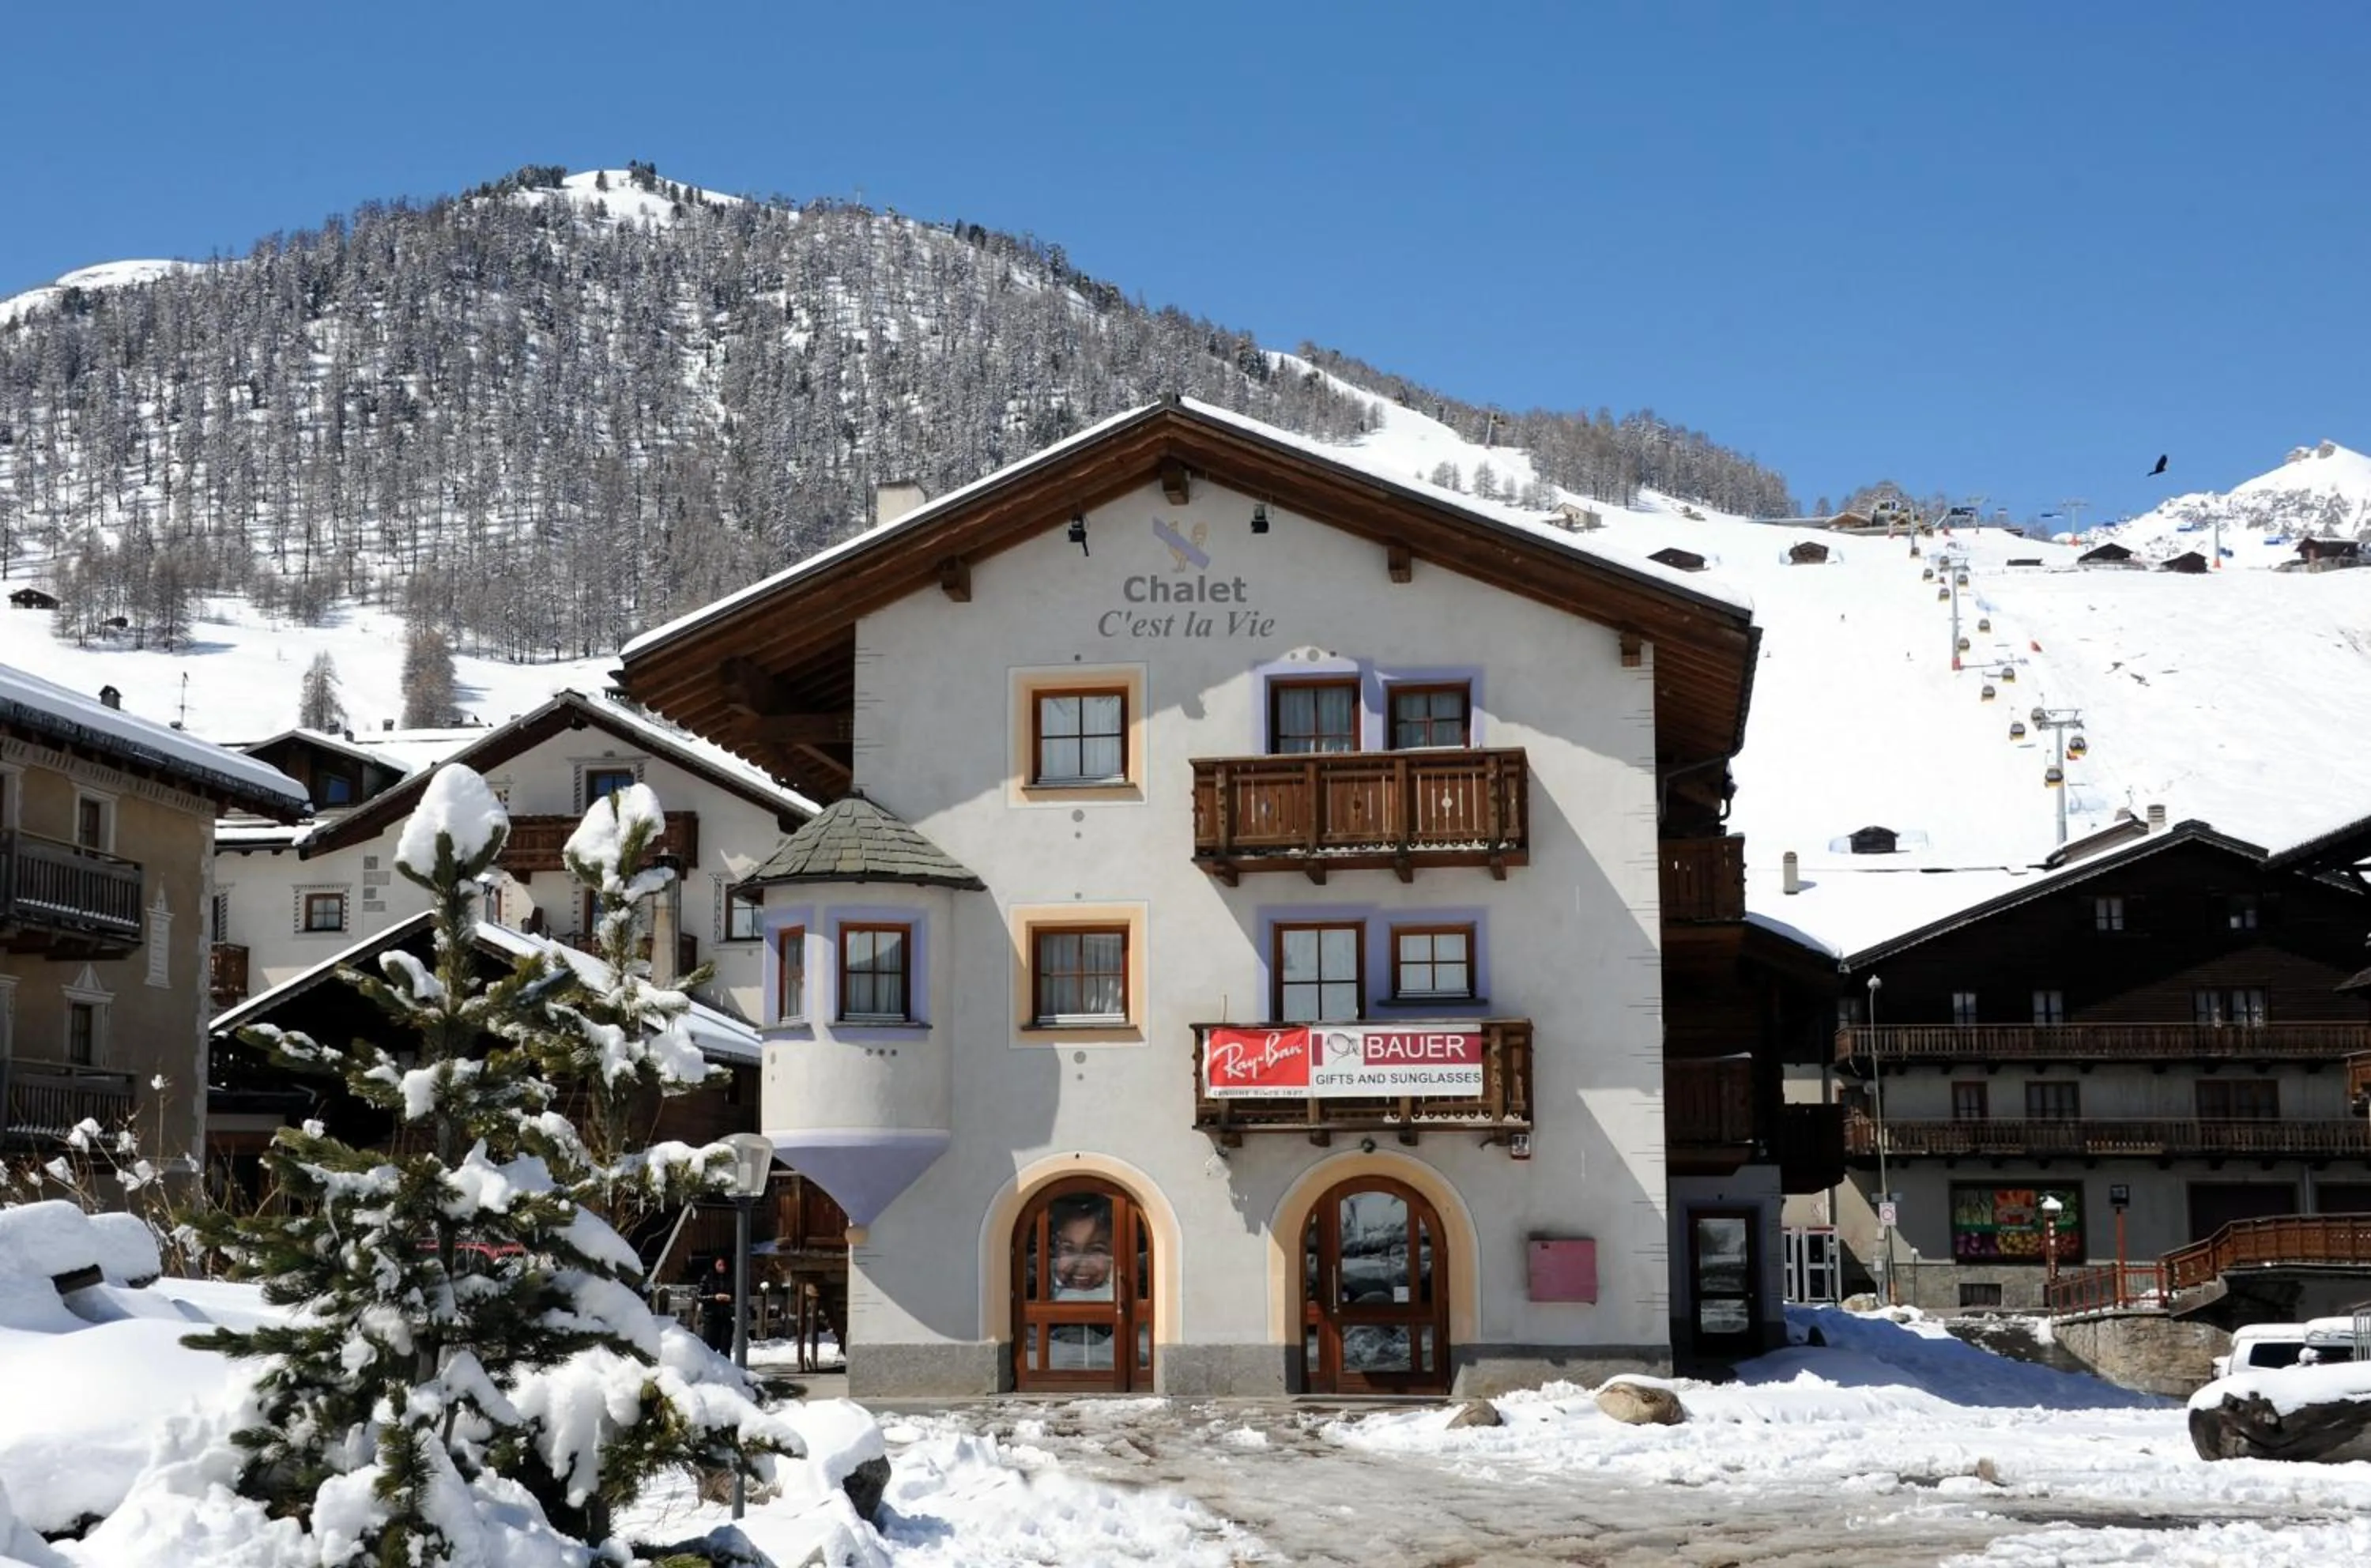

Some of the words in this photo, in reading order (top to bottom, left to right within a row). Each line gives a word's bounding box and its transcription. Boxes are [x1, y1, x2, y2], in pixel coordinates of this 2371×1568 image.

[1122, 575, 1247, 604] Chalet
[1098, 610, 1175, 638] C'est
[1186, 611, 1213, 638] la
[1227, 611, 1276, 638] Vie
[1212, 1031, 1303, 1080] Ray-Ban
[1366, 1035, 1466, 1059] BAUER
[1315, 1074, 1354, 1085] GIFTS
[1358, 1073, 1386, 1084] AND
[1389, 1072, 1482, 1084] SUNGLASSES
